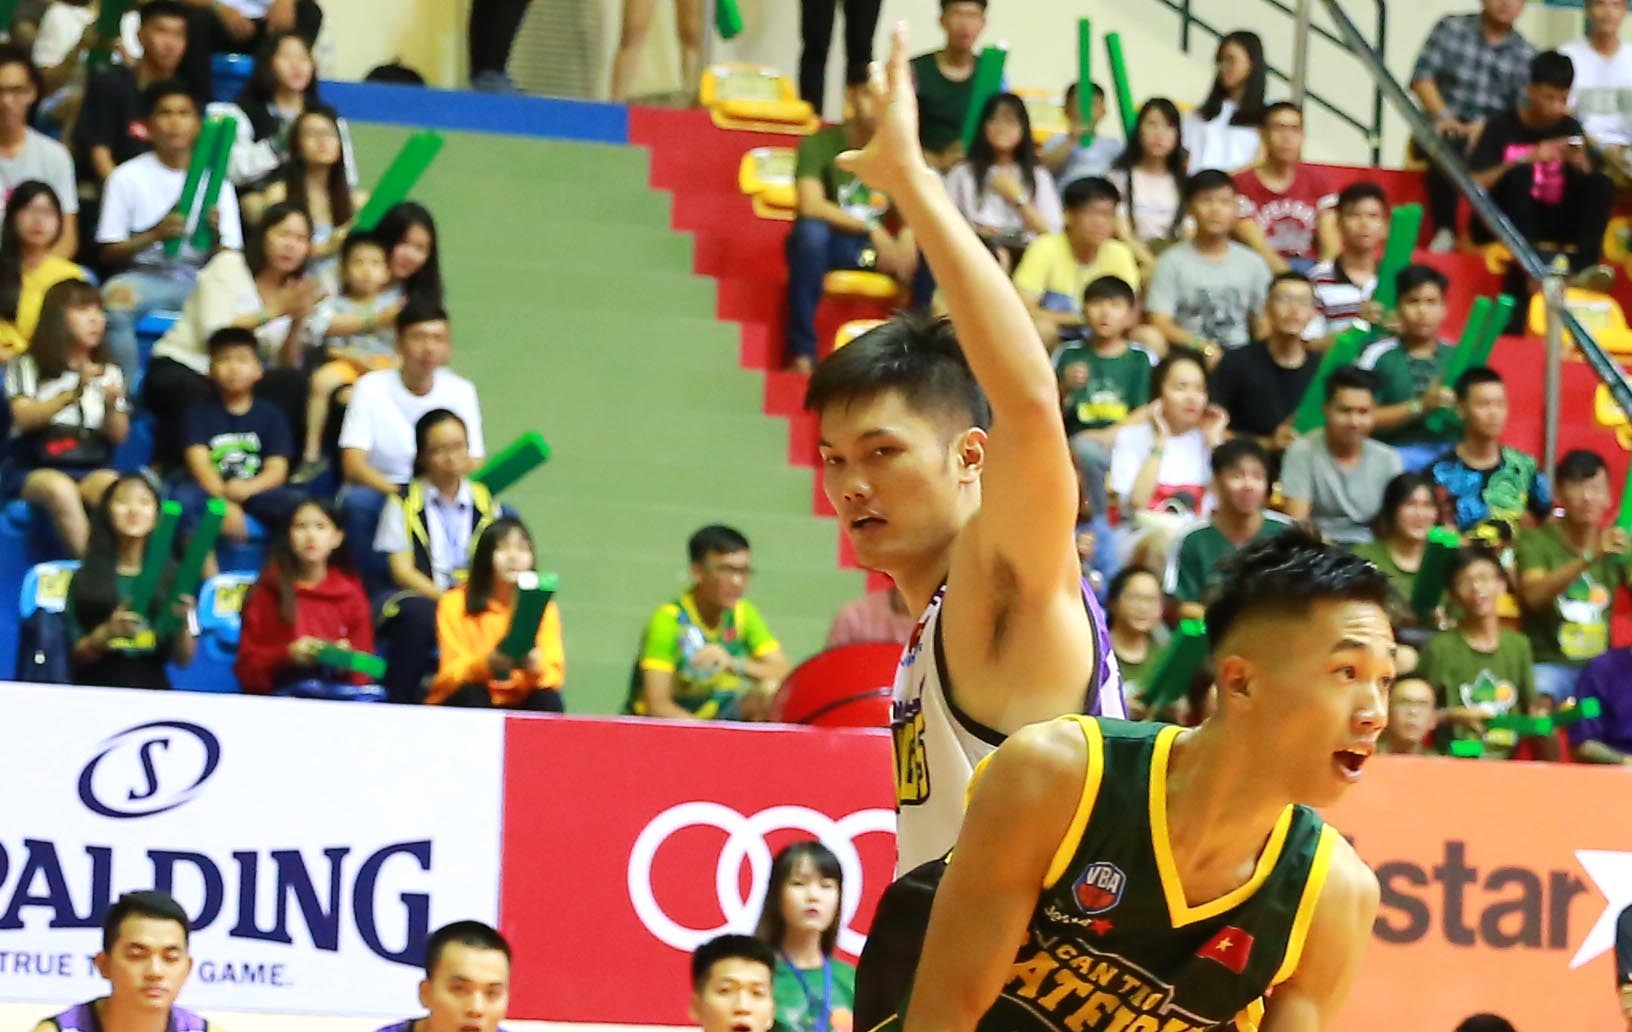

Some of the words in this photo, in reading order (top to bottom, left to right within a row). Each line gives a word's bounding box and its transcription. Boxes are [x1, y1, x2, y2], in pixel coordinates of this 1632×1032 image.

[0, 838, 431, 968] ALDING
[1085, 865, 1121, 894] VBA
[1350, 838, 1588, 952] star
[1055, 944, 1119, 988] CAN
